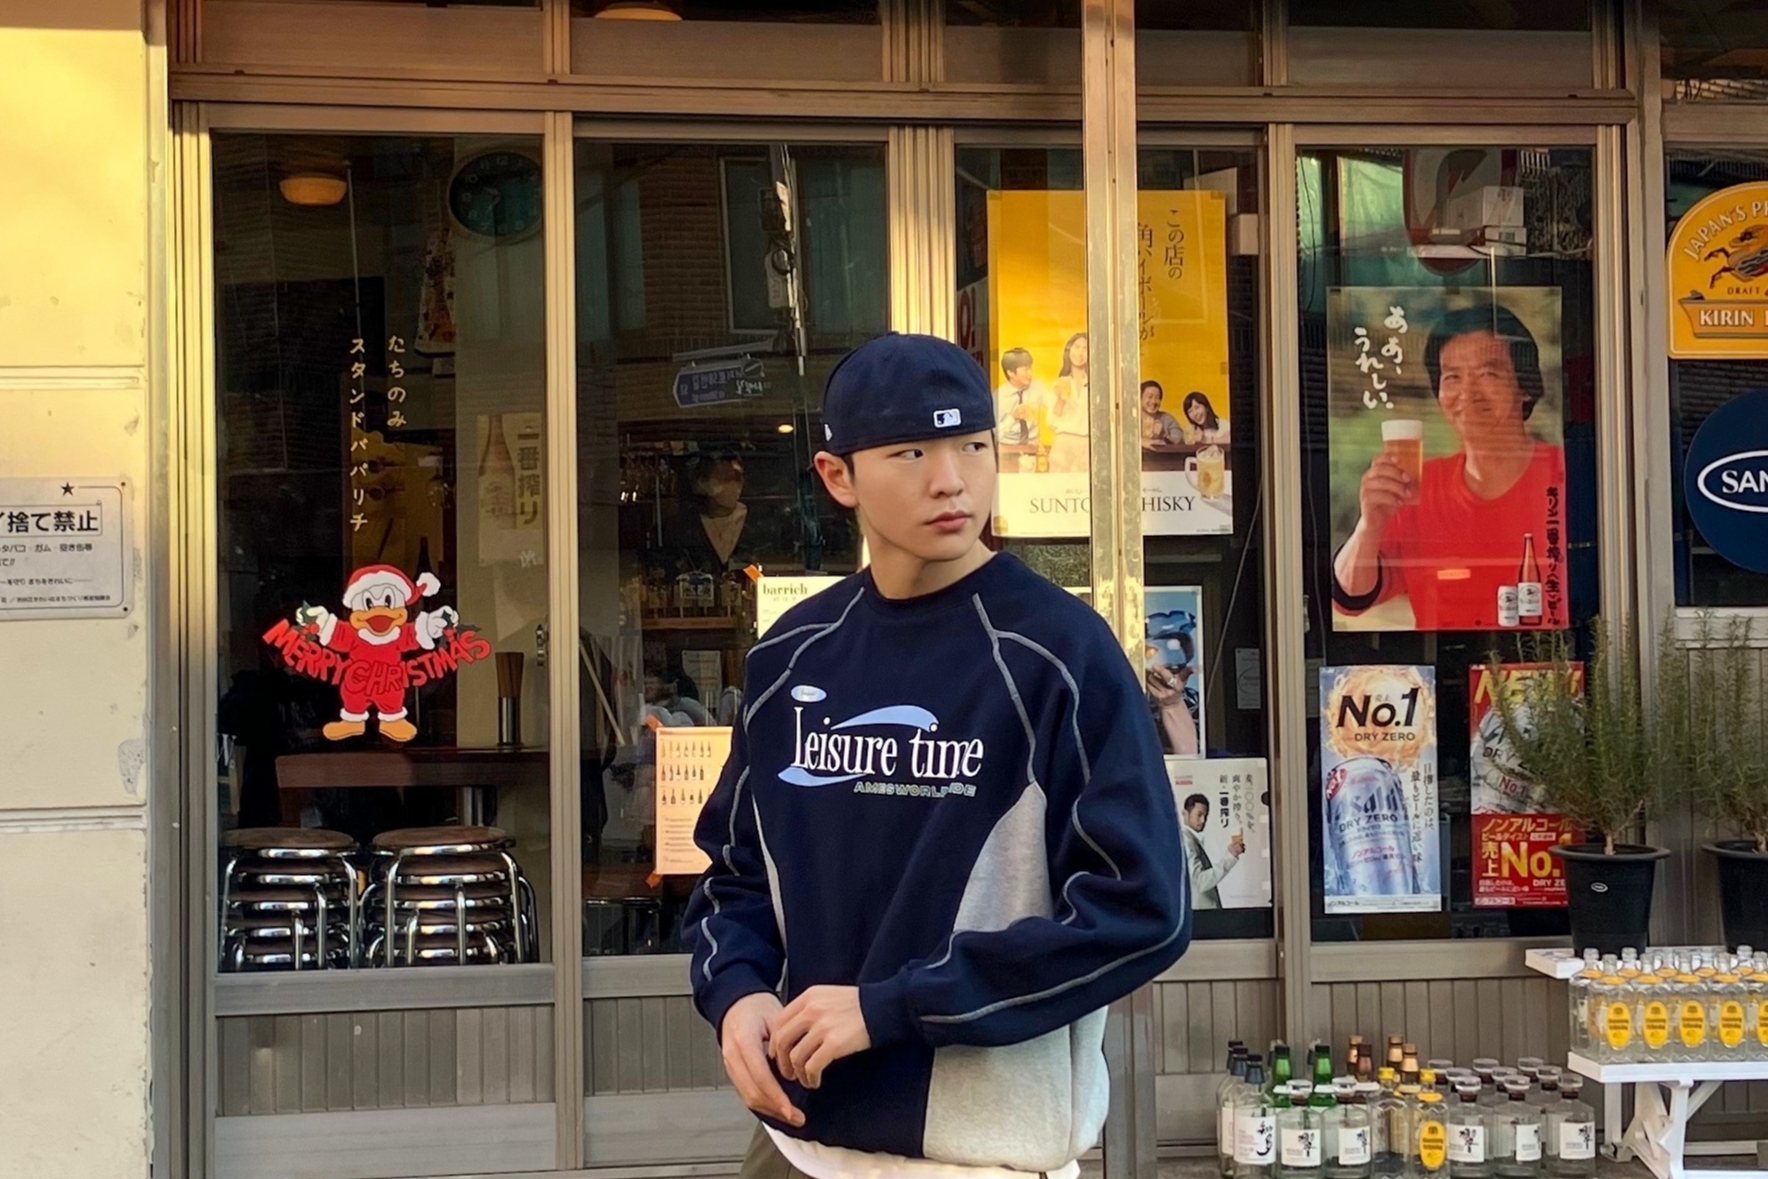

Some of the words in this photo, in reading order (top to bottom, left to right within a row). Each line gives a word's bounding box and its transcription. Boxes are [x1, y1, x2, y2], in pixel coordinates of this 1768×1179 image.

[1164, 209, 1184, 280] この店の
[1683, 204, 1747, 261] JAPAN'S
[1727, 287, 1760, 295] DRAFT
[1700, 310, 1754, 327] KIRIN
[1381, 306, 1408, 375] ああ、
[387, 335, 406, 427] たちのみ
[1354, 327, 1394, 409] うれしい。
[1029, 497, 1090, 514] SUNTO
[1141, 495, 1196, 511] HISKY
[763, 583, 808, 595] barrich
[262, 618, 350, 685] MERRY
[343, 630, 491, 696] CHRISTMAS
[1336, 686, 1422, 728] No.1
[791, 706, 898, 776] Leisure
[1354, 732, 1379, 742] DRY
[1381, 732, 1416, 742] ZERO
[1338, 816, 1362, 833] DRY
[1365, 812, 1398, 824] ZERO
[1482, 817, 1572, 832] ノンアルコール
[1481, 841, 1499, 877] 売上
[1533, 879, 1551, 887] DRY
[1554, 879, 1566, 887] ZE
